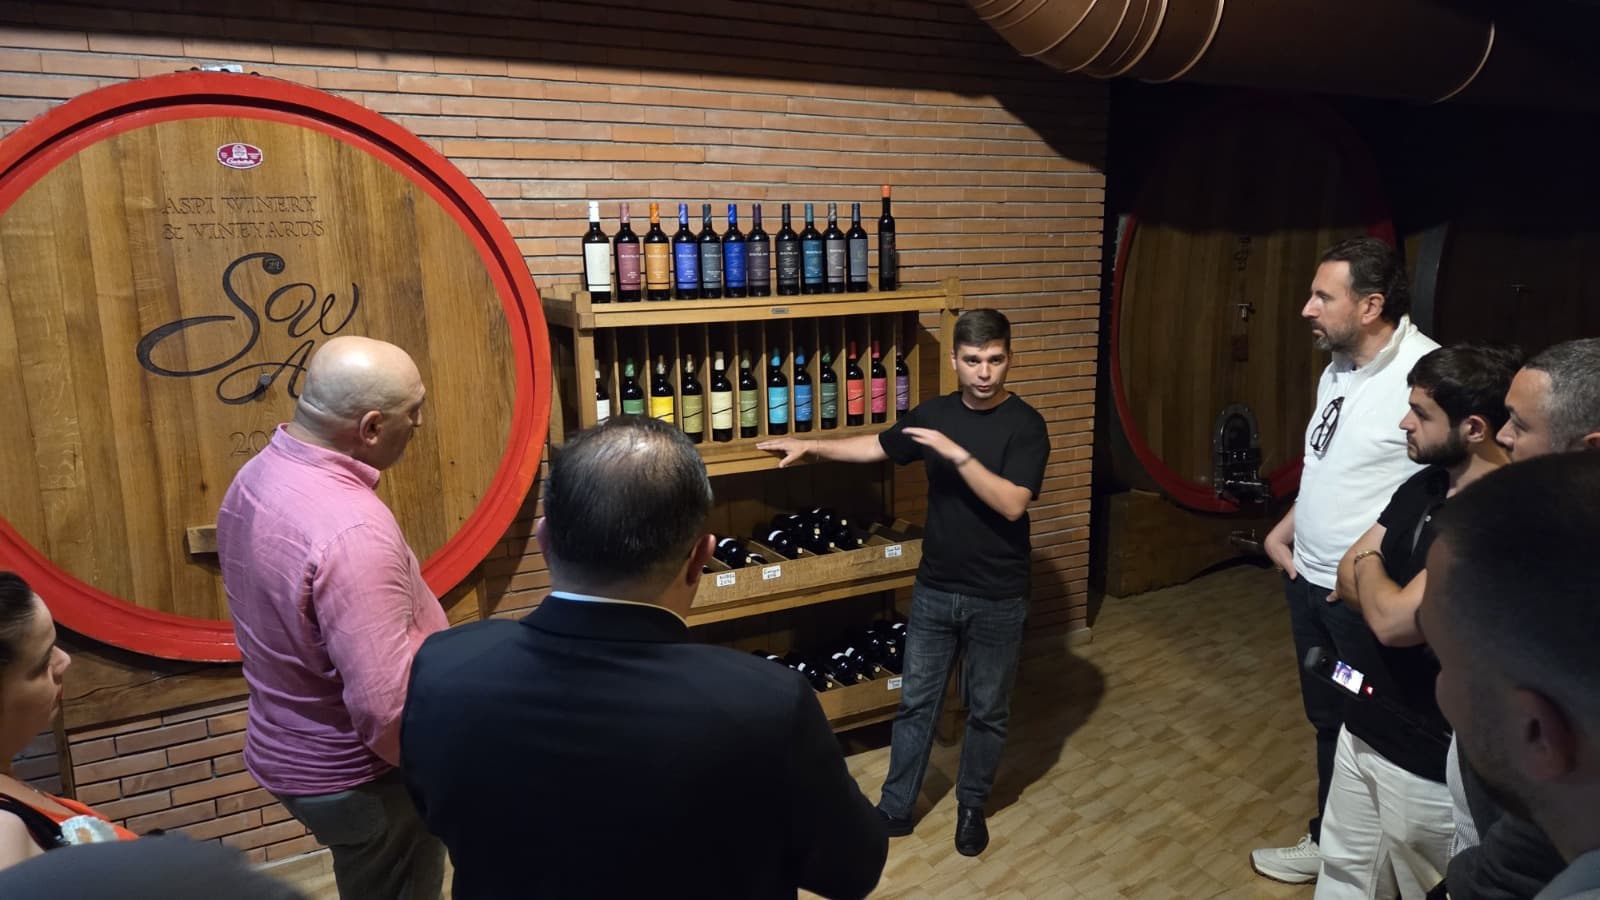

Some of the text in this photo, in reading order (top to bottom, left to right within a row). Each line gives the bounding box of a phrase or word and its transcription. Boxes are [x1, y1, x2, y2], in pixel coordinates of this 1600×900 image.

[161, 196, 317, 215] ASPI WINERY
[163, 220, 324, 240] & VINEYARDS
[229, 428, 277, 457] 20
